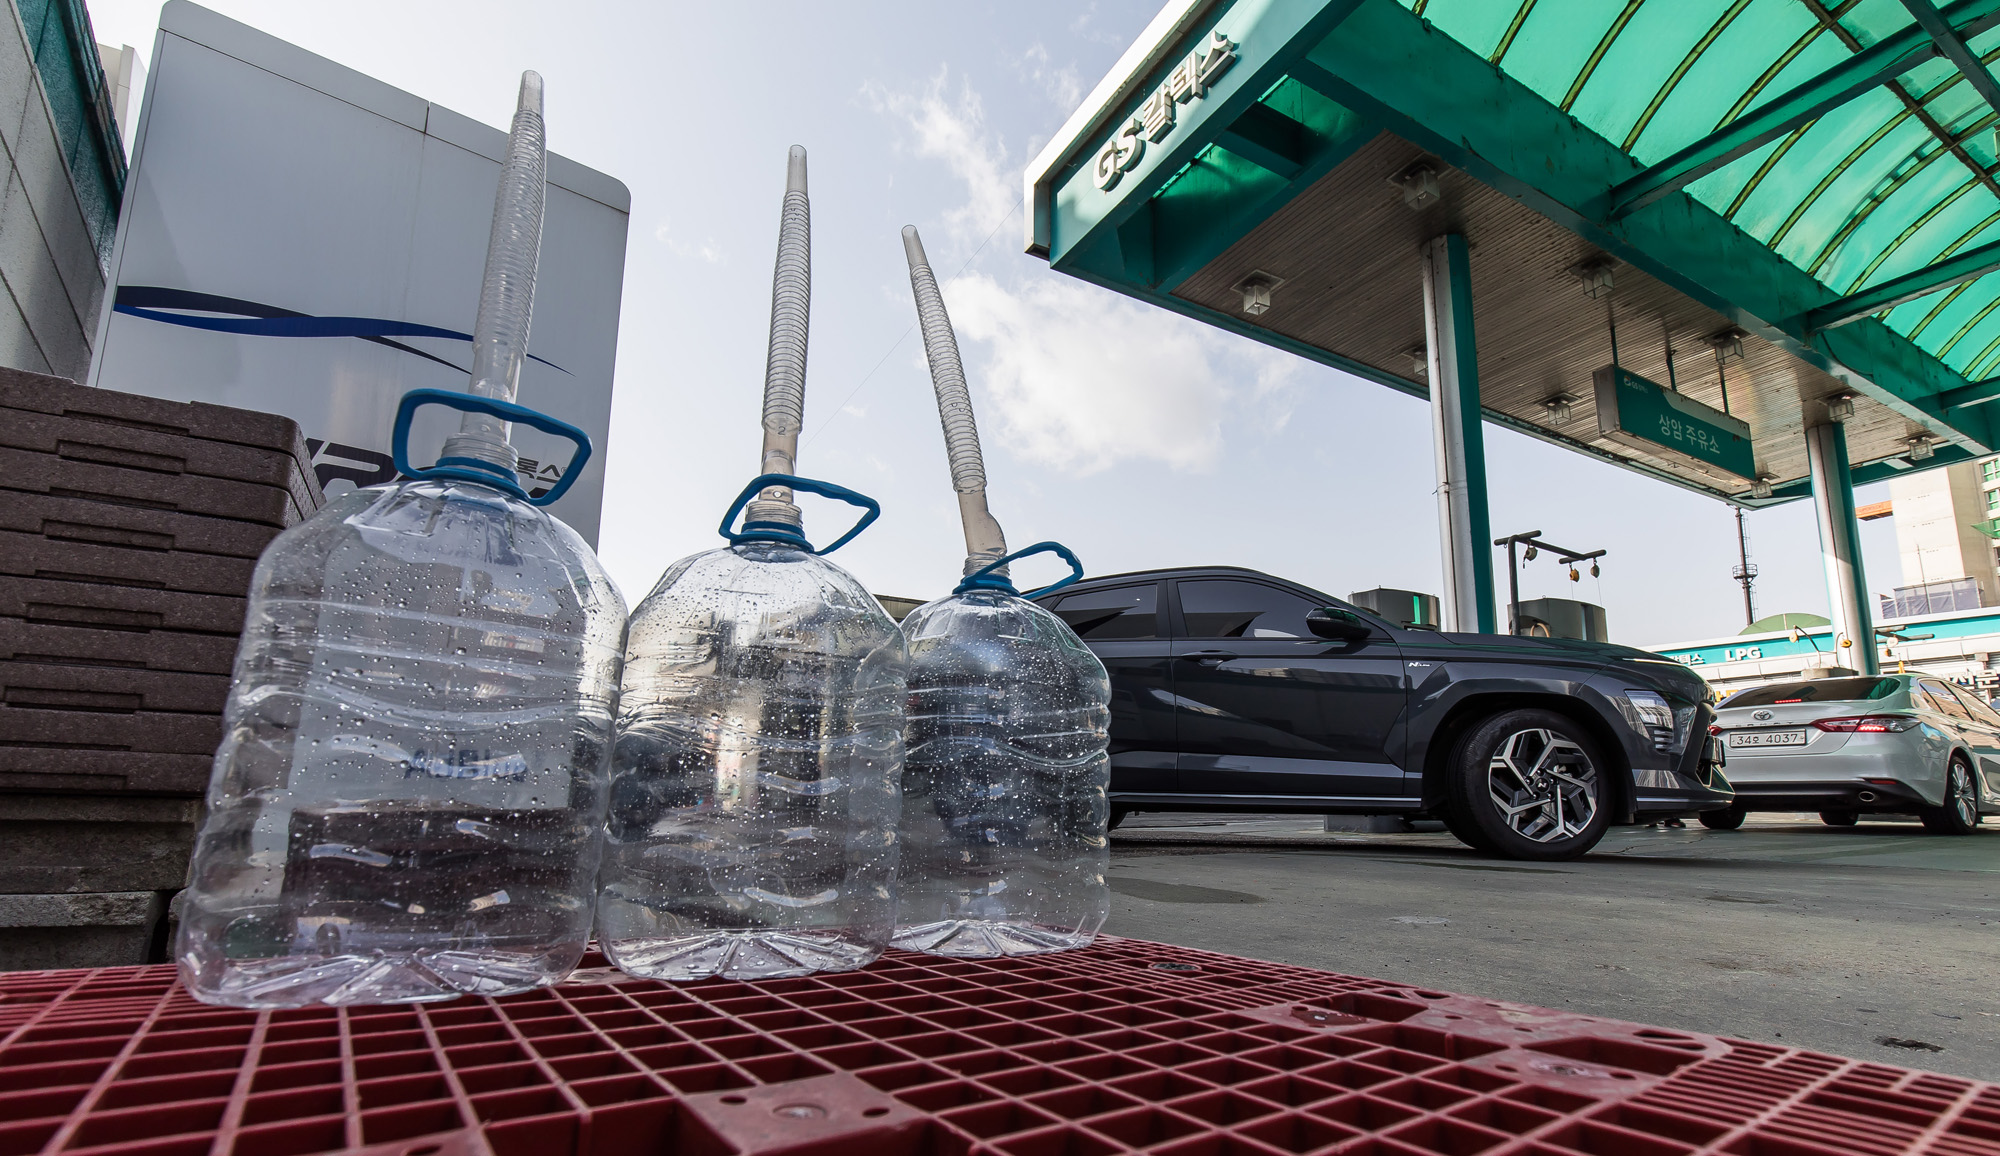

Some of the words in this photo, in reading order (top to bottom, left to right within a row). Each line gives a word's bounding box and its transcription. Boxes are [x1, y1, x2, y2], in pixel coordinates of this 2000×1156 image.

[1093, 30, 1237, 191] GS칼텍스
[1659, 414, 1683, 441] 상암
[1686, 424, 1720, 454] 주유소
[516, 457, 561, 484] 록스
[1724, 646, 1761, 662] LPG
[1766, 733, 1798, 743] 4037
